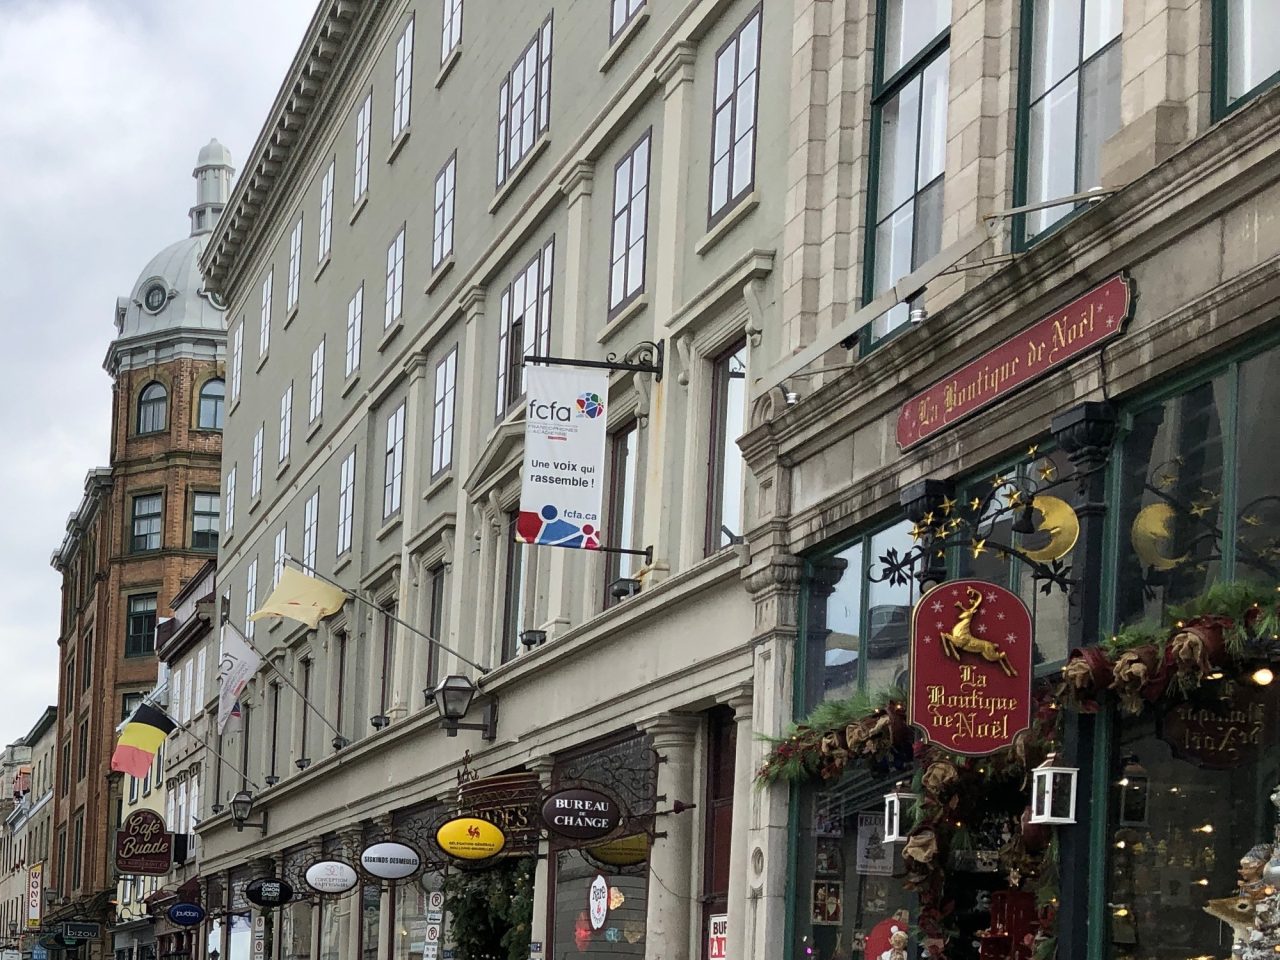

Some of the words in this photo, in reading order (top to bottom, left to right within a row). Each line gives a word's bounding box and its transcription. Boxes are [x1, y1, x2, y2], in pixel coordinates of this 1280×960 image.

[918, 396, 939, 434] La
[943, 356, 1020, 424] Boutique
[1027, 340, 1046, 368] de
[1049, 303, 1095, 364] Noël
[529, 399, 571, 422] fcfa
[531, 459, 550, 469] Une
[553, 461, 578, 472] voix
[580, 465, 595, 475] qui
[530, 474, 589, 488] rassemble
[563, 509, 597, 521] fcfa.ca
[959, 665, 987, 693] La
[927, 685, 1018, 716] Boutique
[932, 707, 954, 728] de
[952, 712, 1009, 745] Noël
[555, 799, 609, 812] BUREAU
[129, 815, 161, 841] Café
[554, 815, 609, 828] CHANGE
[120, 837, 169, 858] Buade
[364, 856, 389, 864] SISKINDS
[389, 857, 418, 866] DESMEULES
[30, 871, 40, 908] WONG
[67, 925, 97, 937] bizou
